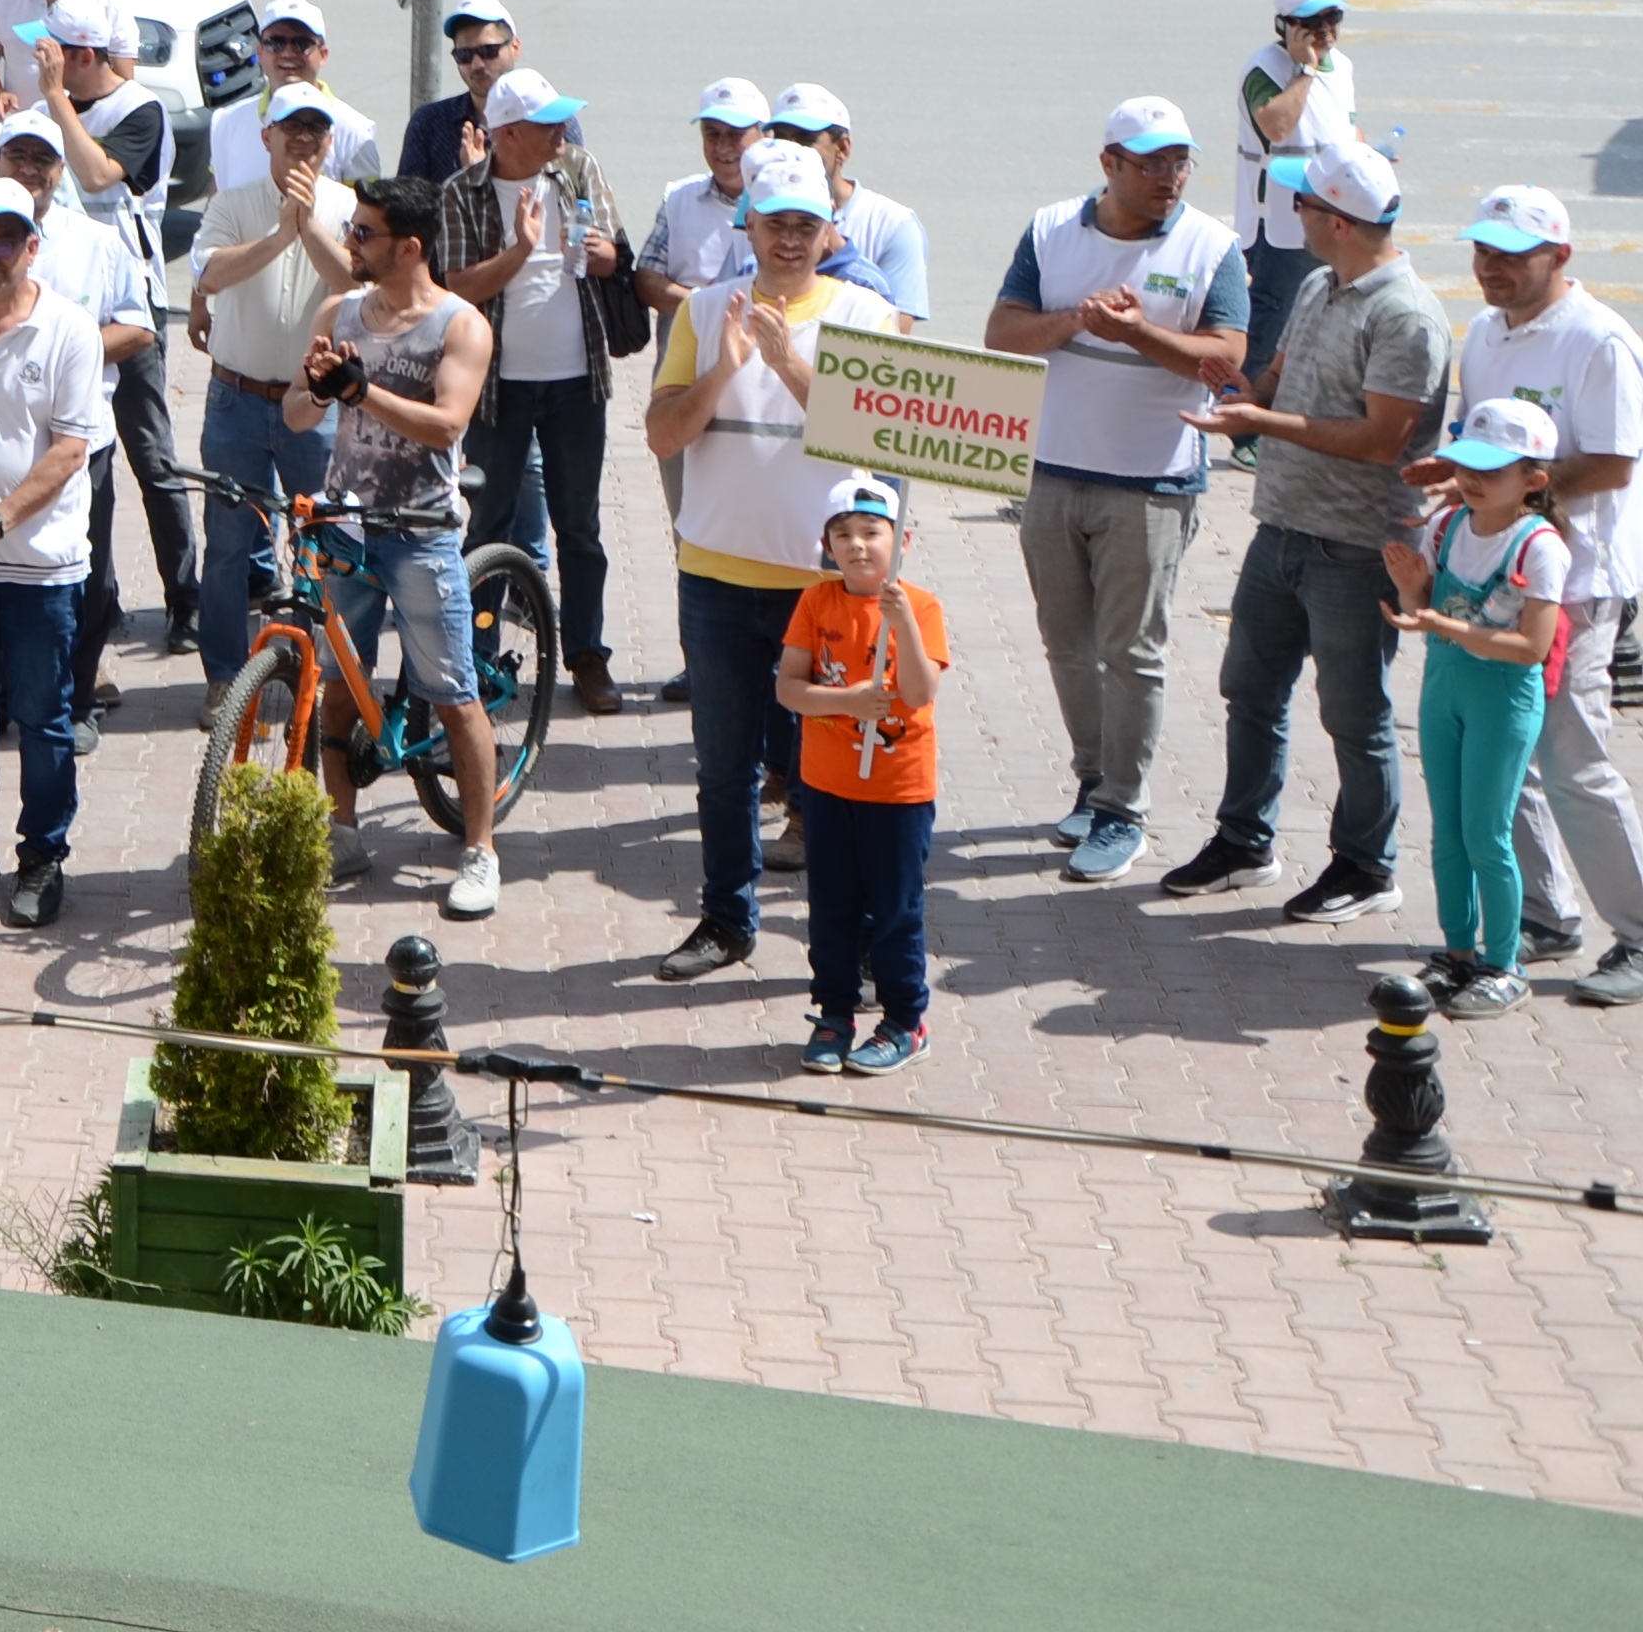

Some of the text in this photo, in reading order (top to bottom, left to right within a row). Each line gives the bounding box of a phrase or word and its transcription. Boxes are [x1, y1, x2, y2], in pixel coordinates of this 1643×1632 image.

[817, 350, 956, 400] DOĞAYI
[853, 387, 1030, 443] KORUMAK
[872, 426, 1030, 477] ELİMİZDE
